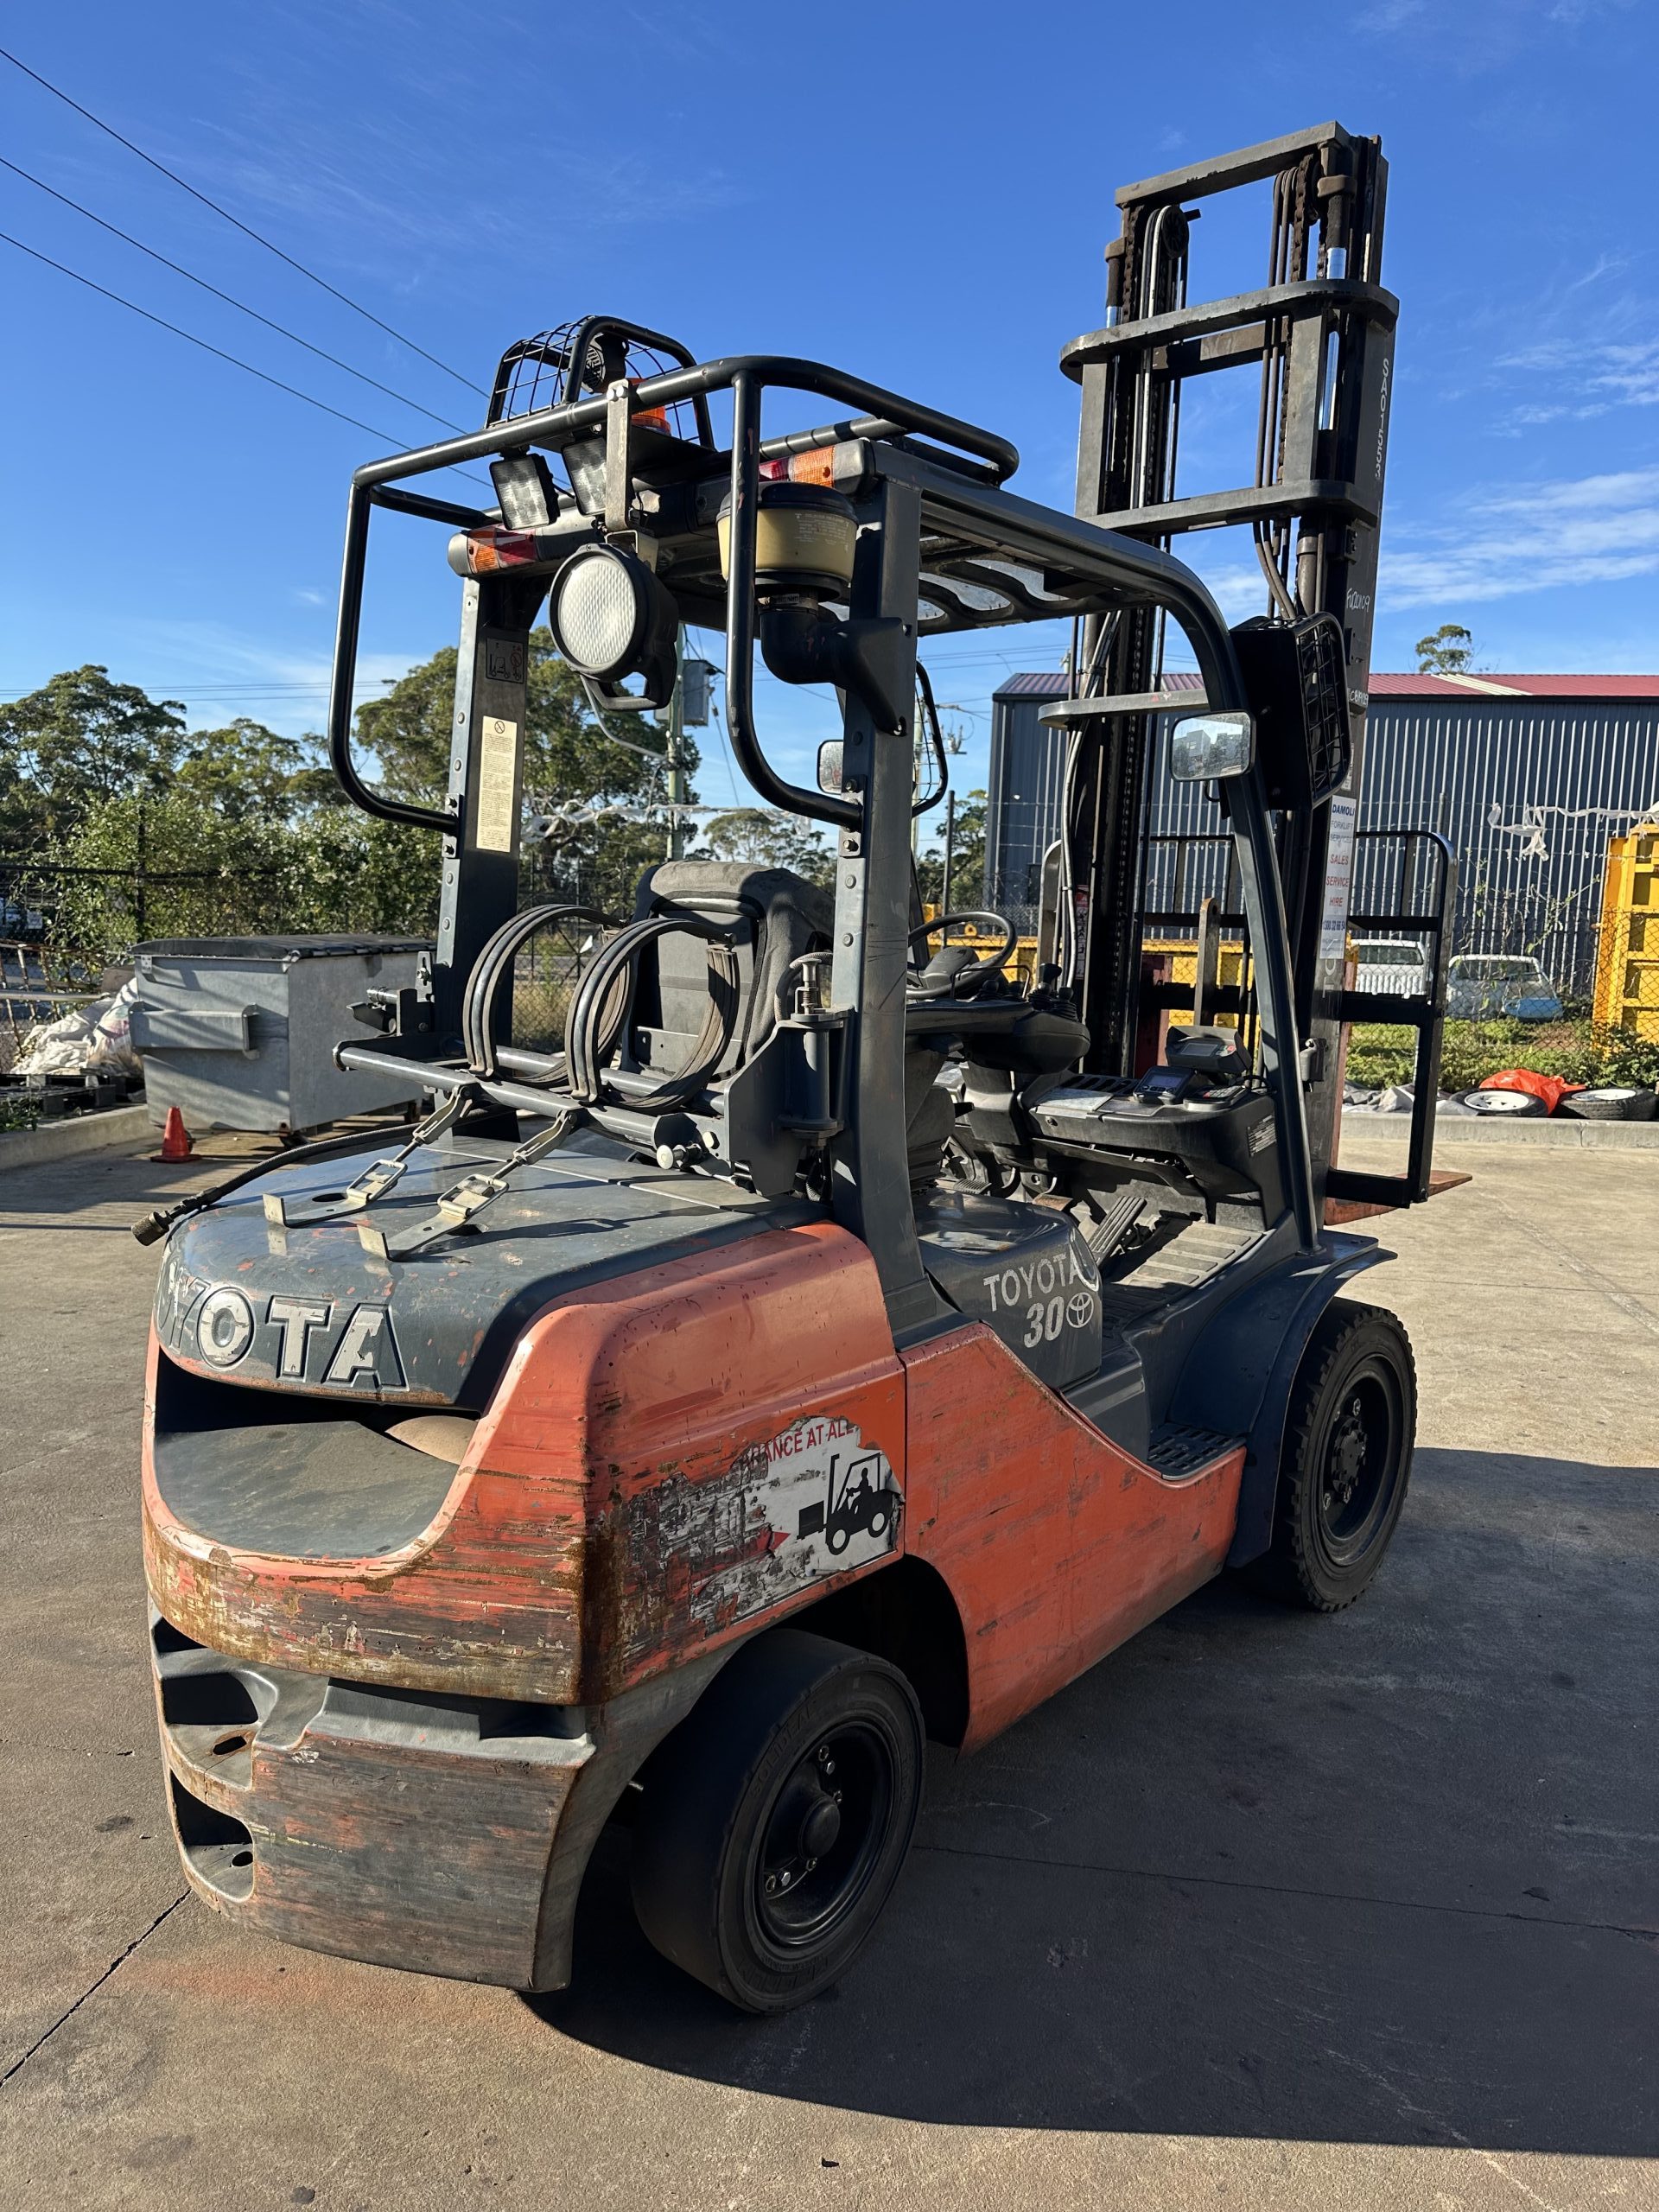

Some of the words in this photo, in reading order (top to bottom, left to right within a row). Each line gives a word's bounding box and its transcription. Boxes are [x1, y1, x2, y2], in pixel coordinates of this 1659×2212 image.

[1331, 820, 1354, 830] FORKLIFT
[1331, 854, 1349, 865] SALES
[1325, 876, 1350, 887] SERVICE
[1329, 897, 1343, 906] HIRE
[982, 1245, 1081, 1312] TOYOTA
[1024, 1295, 1065, 1348] 30
[806, 1424, 824, 1449] AT
